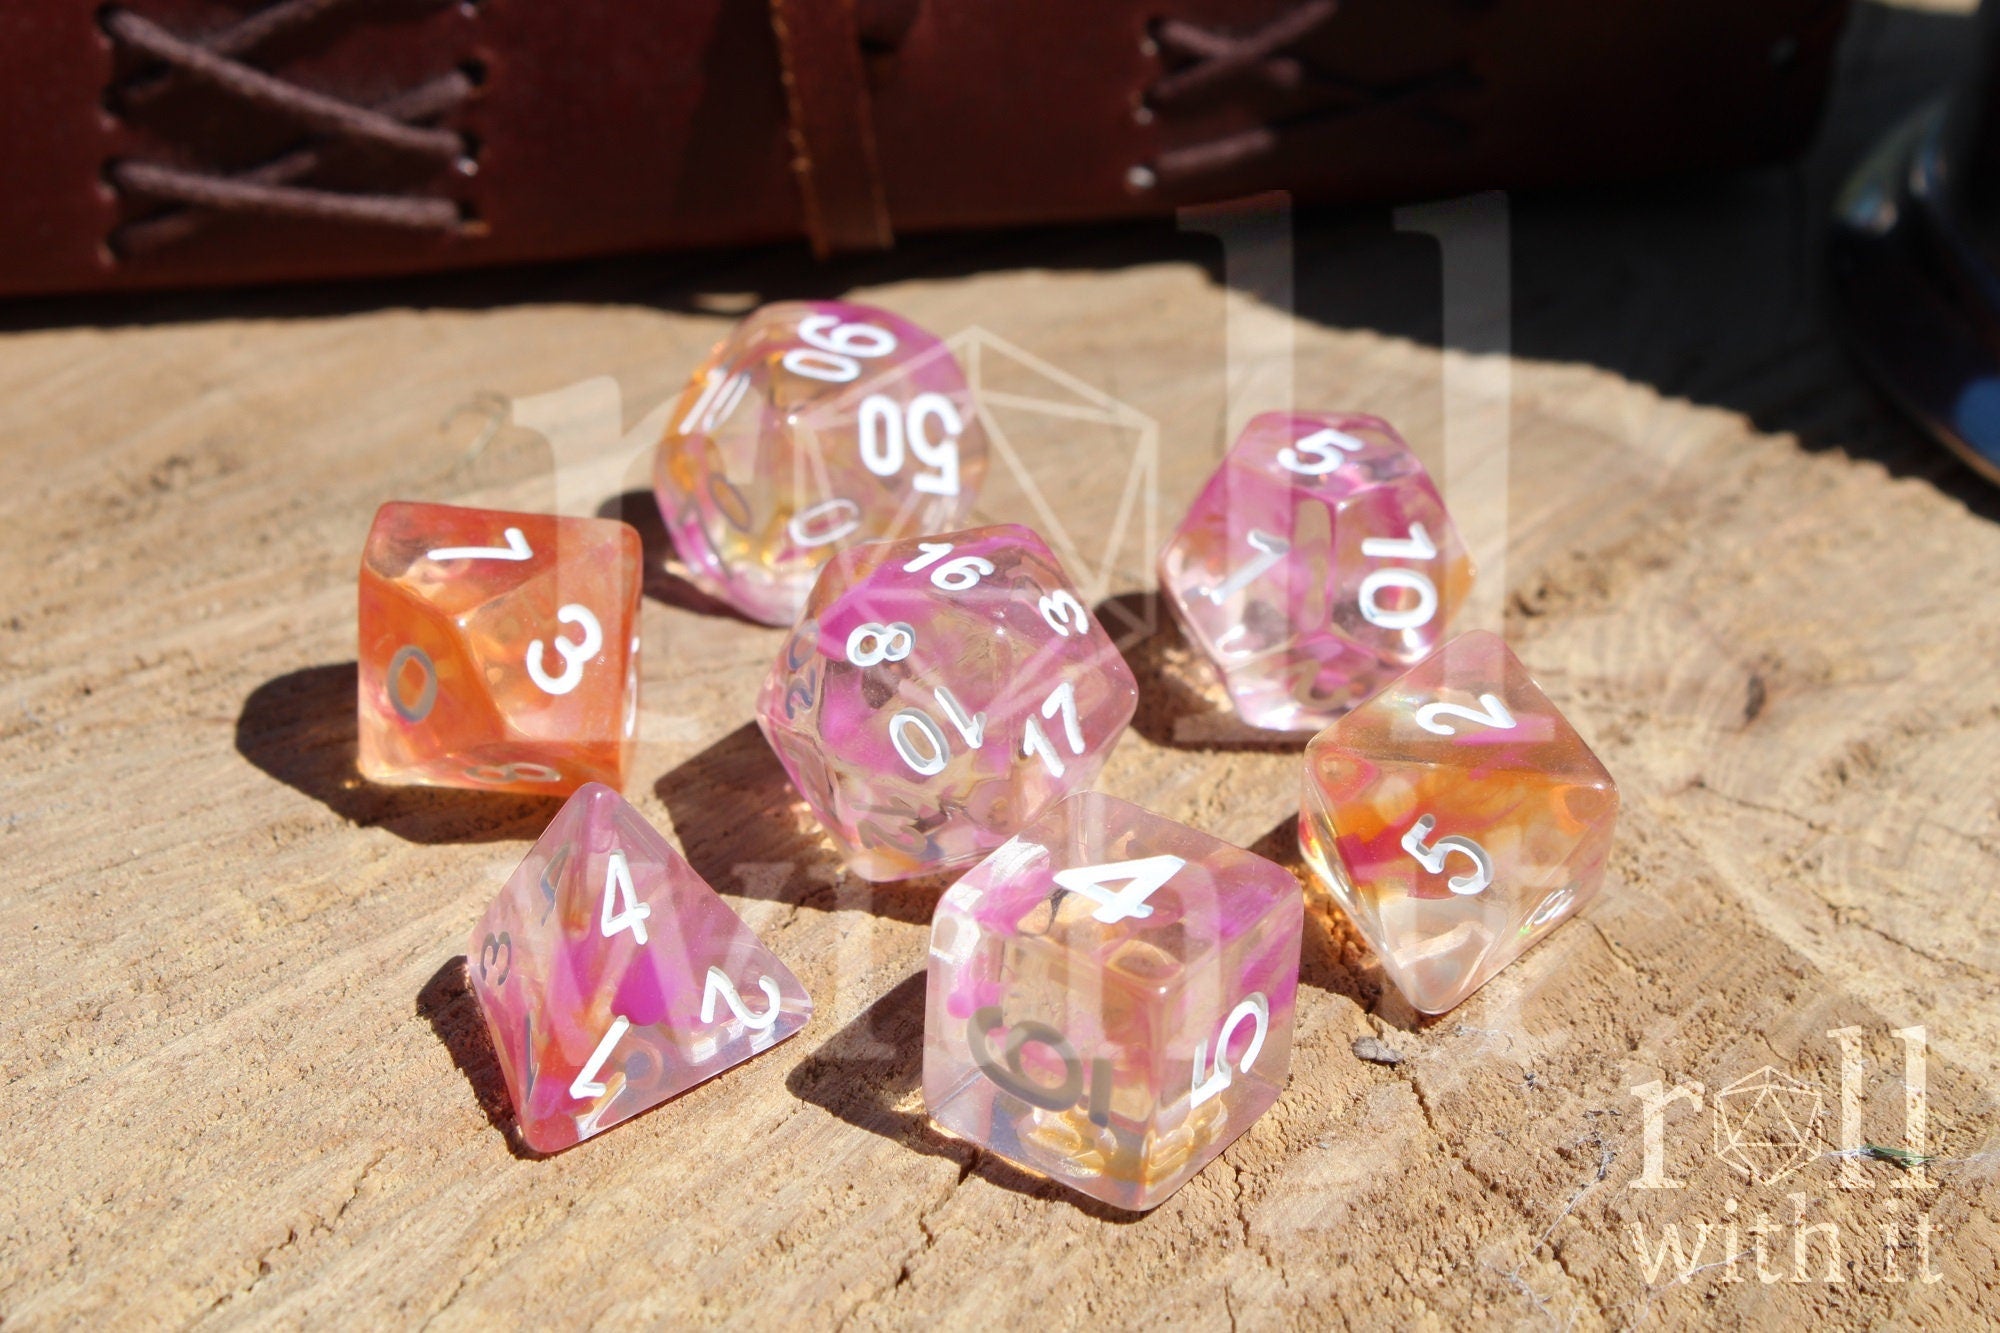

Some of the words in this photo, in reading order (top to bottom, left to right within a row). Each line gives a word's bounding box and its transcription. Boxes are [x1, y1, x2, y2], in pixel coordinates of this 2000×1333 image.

[858, 392, 963, 496] 50
[1276, 428, 1365, 475] 5
[427, 527, 534, 561] 1
[903, 542, 995, 591] 16
[1358, 520, 1438, 630] 10
[526, 603, 603, 695] 3
[846, 621, 916, 667] 8
[1038, 589, 1089, 637] 3
[888, 686, 987, 776] 10
[1021, 682, 1085, 778] 17
[1415, 694, 1518, 736] 2
[1053, 854, 1187, 924] 4
[1401, 813, 1493, 895] 5
[600, 849, 651, 945] 4
[480, 931, 512, 986] 3
[700, 965, 781, 1030] 2
[569, 1014, 630, 1099] 1
[1191, 991, 1270, 1110] 5
